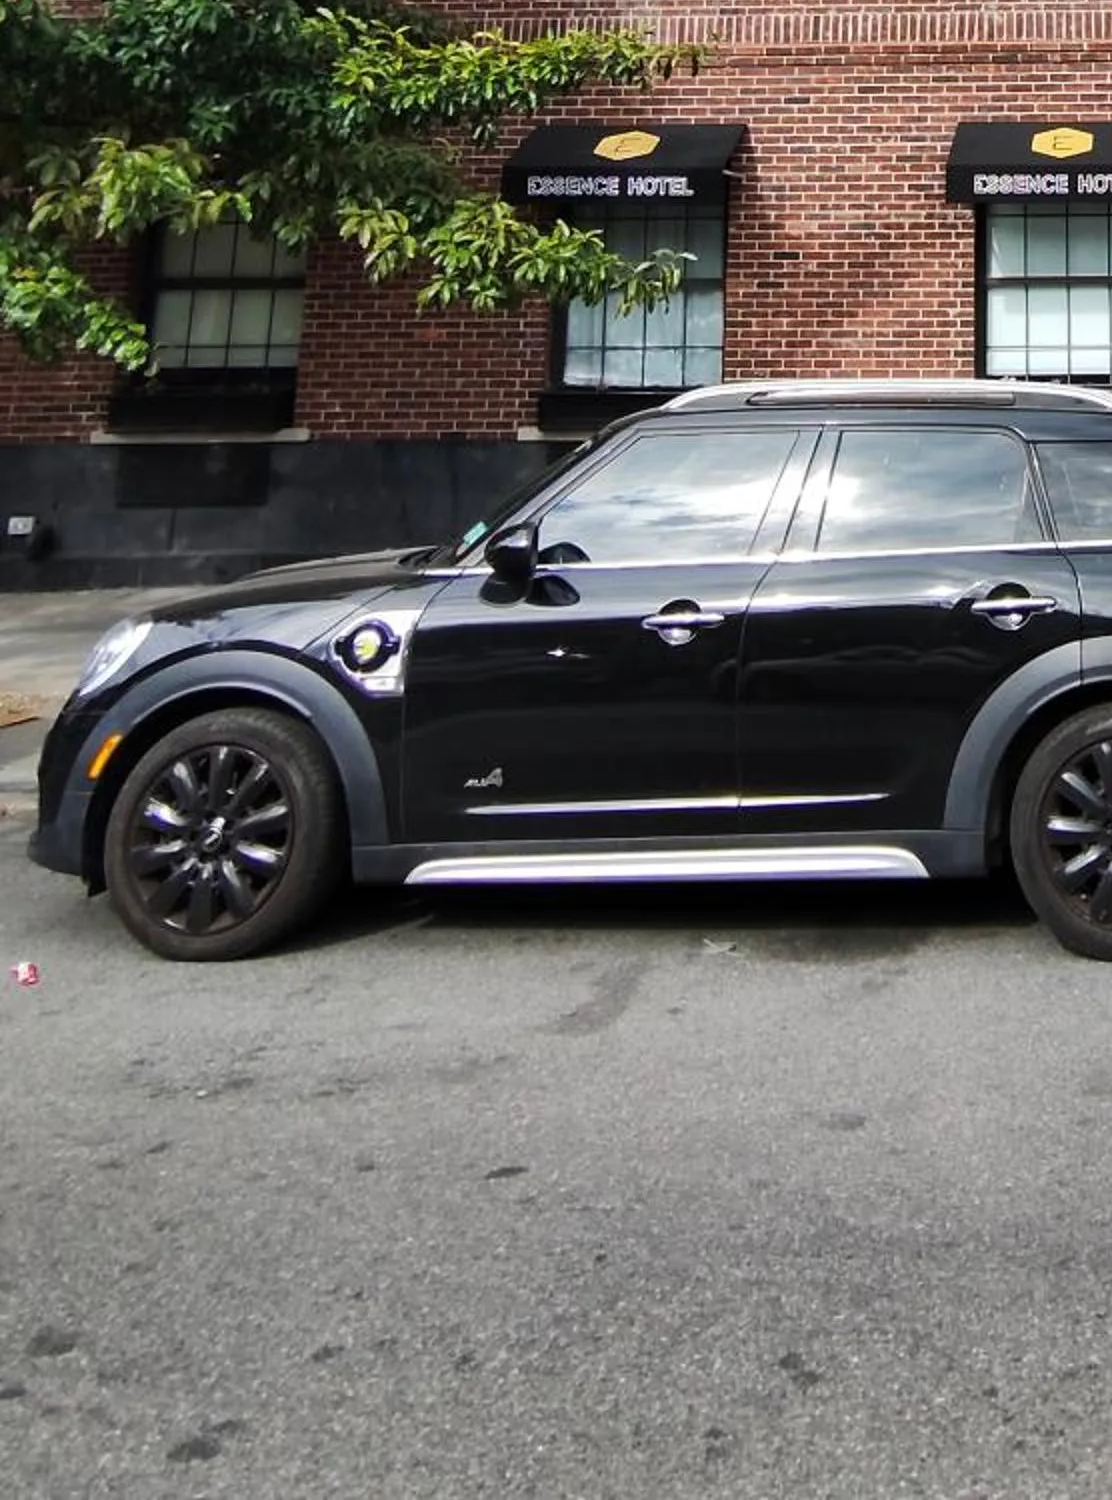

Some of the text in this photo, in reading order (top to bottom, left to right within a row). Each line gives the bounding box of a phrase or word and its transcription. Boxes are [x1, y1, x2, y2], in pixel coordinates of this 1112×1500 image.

[527, 175, 694, 196] ESSENCE HOTEL
[973, 173, 1069, 195] ESSENCE
